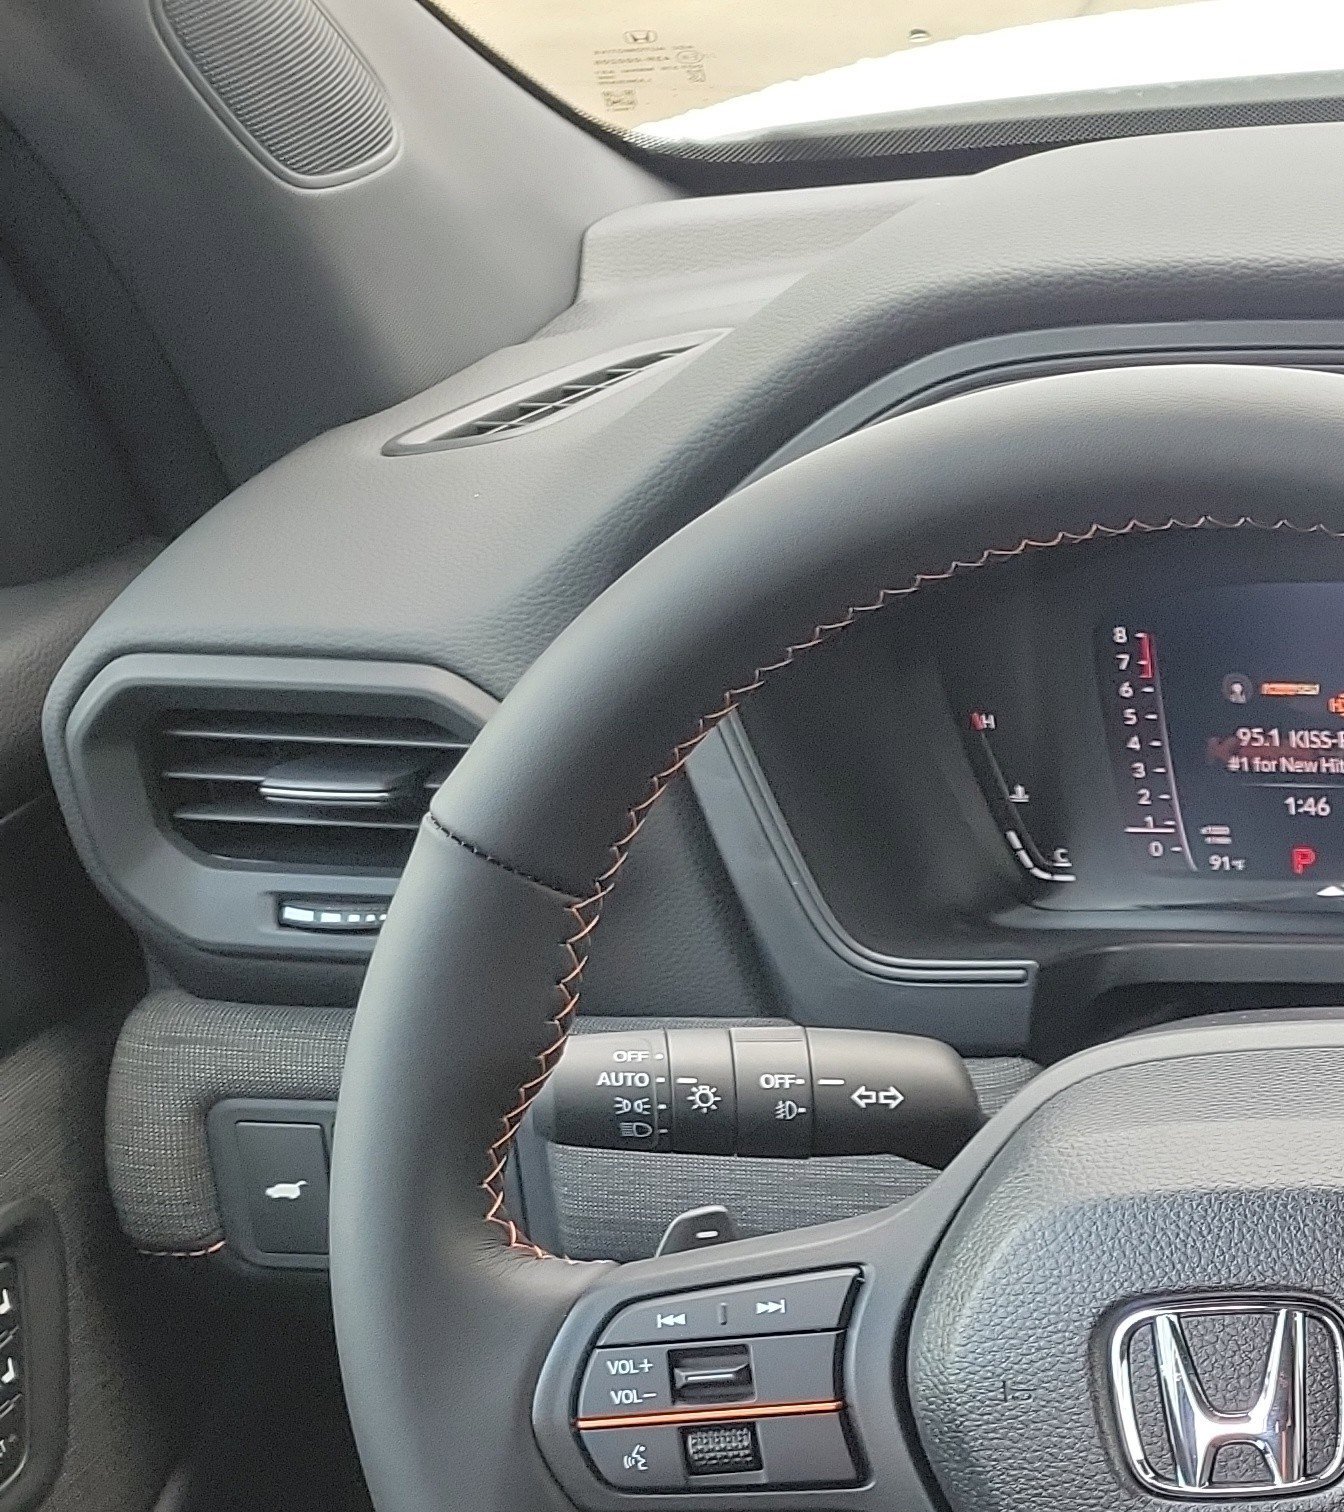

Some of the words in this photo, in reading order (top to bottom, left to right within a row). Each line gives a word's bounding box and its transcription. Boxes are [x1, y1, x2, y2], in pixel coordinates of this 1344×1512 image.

[1113, 627, 1128, 643] 8
[1116, 654, 1130, 670] 7
[1118, 682, 1134, 698] 6
[982, 714, 996, 729] H
[1123, 708, 1137, 725] 5
[1126, 735, 1141, 750] 4
[1236, 727, 1280, 747] 95.1
[1131, 762, 1145, 778] 3
[1227, 757, 1249, 772] #1
[1253, 757, 1277, 772] for
[1280, 757, 1318, 773] New
[1137, 788, 1152, 805] 2
[1284, 796, 1331, 816] 1:46
[1144, 816, 1154, 829] 1
[1149, 841, 1164, 857] 0
[1292, 848, 1316, 874] P
[613, 1051, 649, 1063] OFF
[596, 1072, 650, 1087] AUTO
[760, 1074, 797, 1089] OFF
